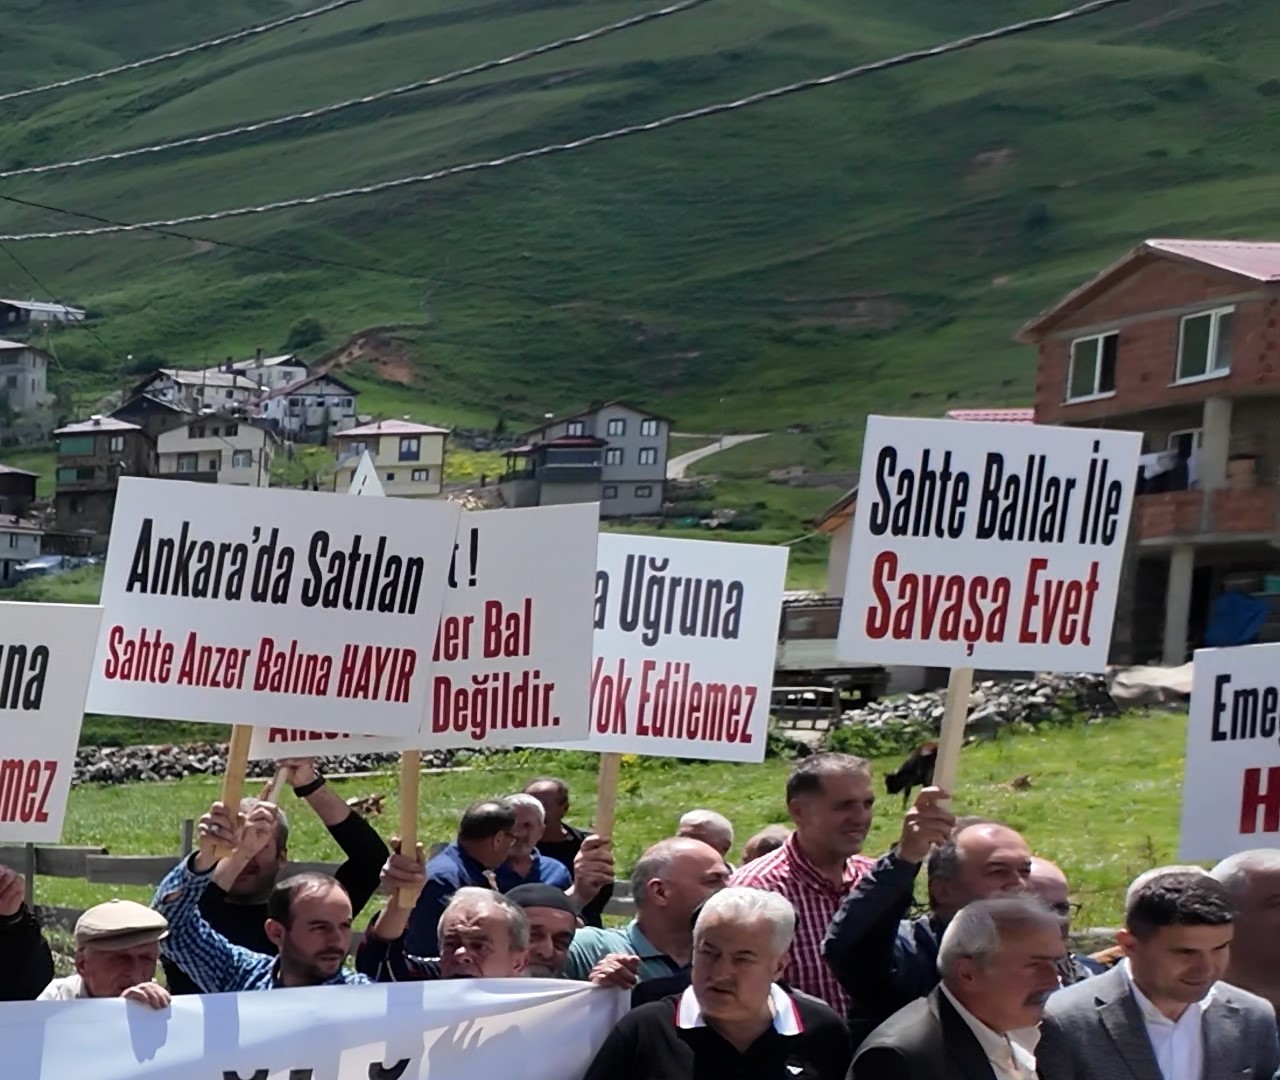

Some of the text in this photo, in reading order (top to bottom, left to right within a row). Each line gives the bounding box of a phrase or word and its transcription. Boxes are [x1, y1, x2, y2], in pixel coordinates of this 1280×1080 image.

[869, 439, 1123, 547] Sahte Ballar İle
[125, 517, 295, 605] Ankara'da
[300, 530, 425, 615] Satılan
[618, 553, 744, 647] Uğruna
[865, 550, 1100, 657] Savaşa Evet
[104, 625, 417, 704] Sahte Anzer Balına HAYIR
[431, 615, 475, 663] er
[483, 597, 532, 659] Bal
[431, 669, 561, 741] Değildir.
[635, 659, 757, 744] Edilemez
[1210, 673, 1279, 742] Eme
